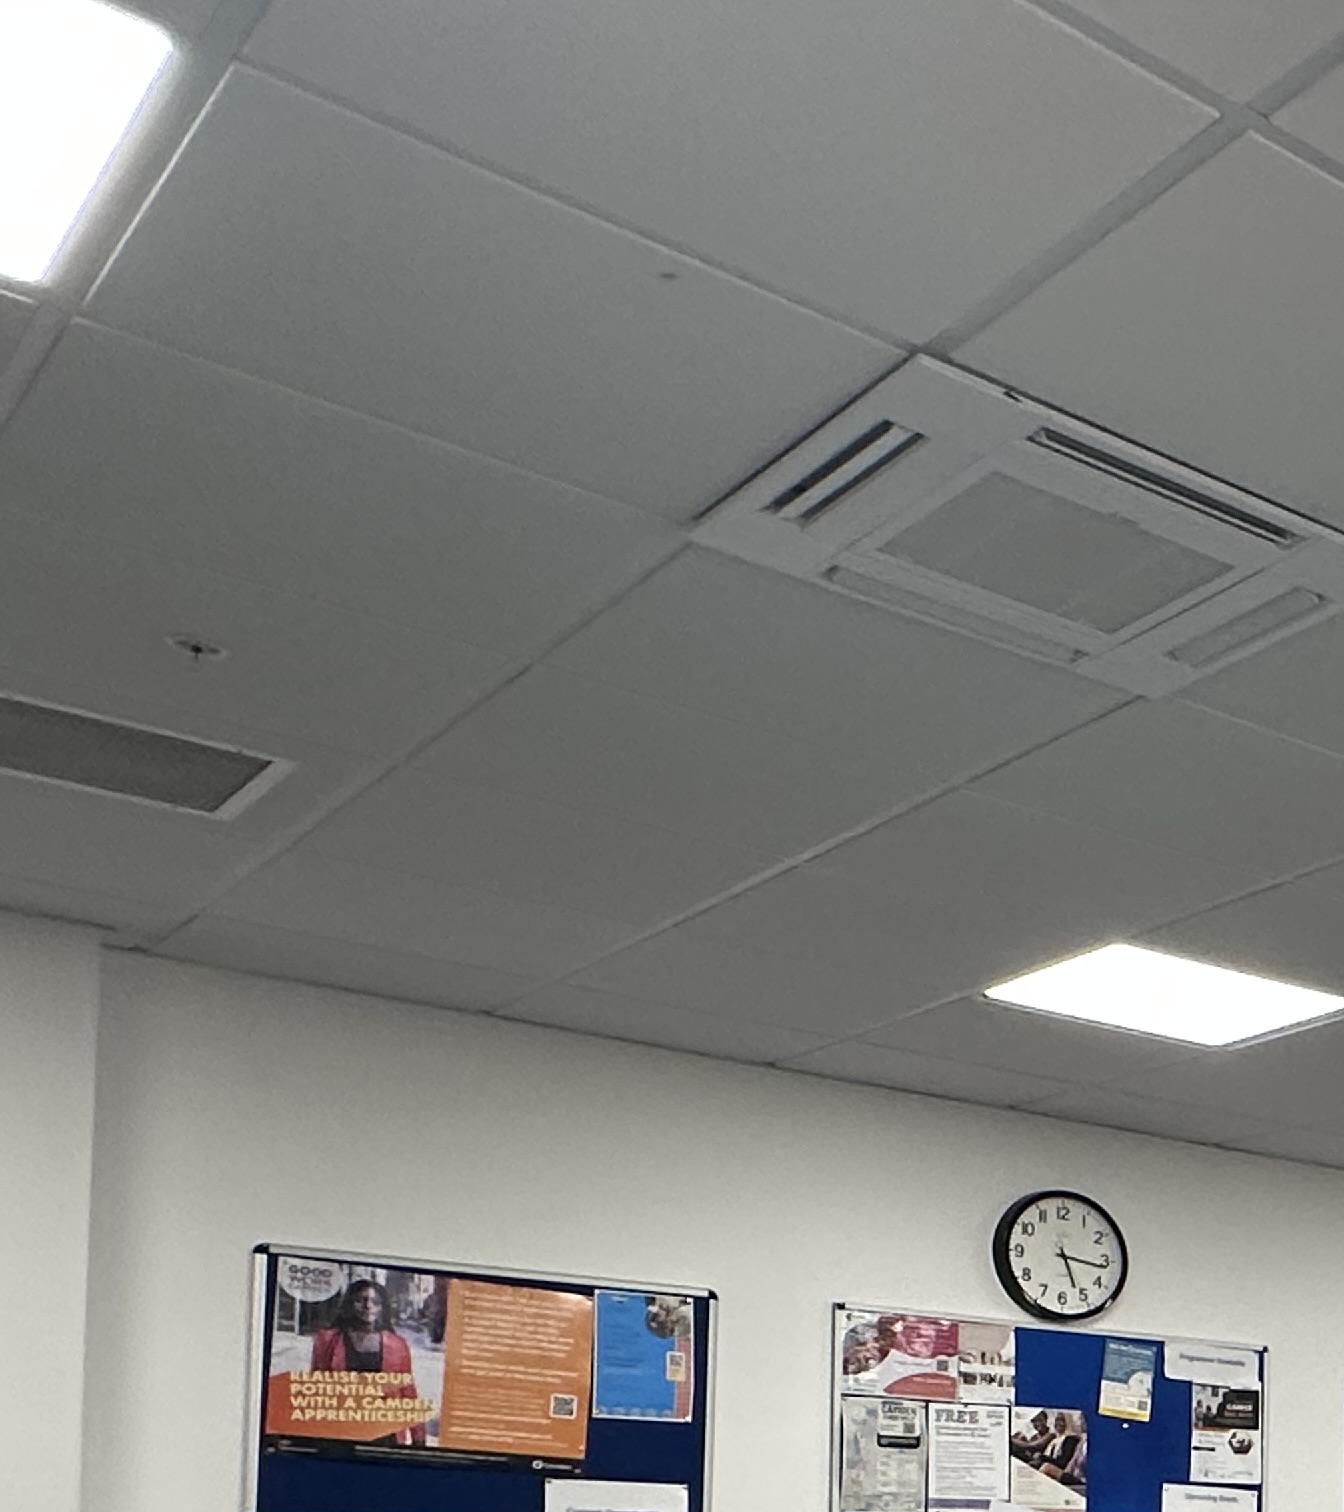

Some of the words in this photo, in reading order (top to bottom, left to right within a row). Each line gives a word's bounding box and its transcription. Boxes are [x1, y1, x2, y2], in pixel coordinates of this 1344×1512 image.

[1039, 1208, 1047, 1223] 11
[1057, 1206, 1070, 1221] 12
[1022, 1221, 1035, 1237] 10
[1093, 1231, 1104, 1245] 2
[1014, 1243, 1024, 1257] 9
[1100, 1254, 1110, 1269] 3
[1022, 1267, 1032, 1281] 8
[1093, 1275, 1102, 1289] 4
[1039, 1283, 1048, 1297] 7
[1078, 1288, 1088, 1301] 5
[1057, 1291, 1068, 1305] 6
[290, 1370, 359, 1383] REALISE
[365, 1372, 412, 1384] YOUR
[290, 1383, 385, 1396] POTENTIAL
[290, 1396, 337, 1408] WITH
[343, 1398, 356, 1408] A
[362, 1398, 437, 1410] CAMDEN
[291, 1408, 434, 1422] APPRENTICESHIP
[934, 1408, 980, 1424] FREE
